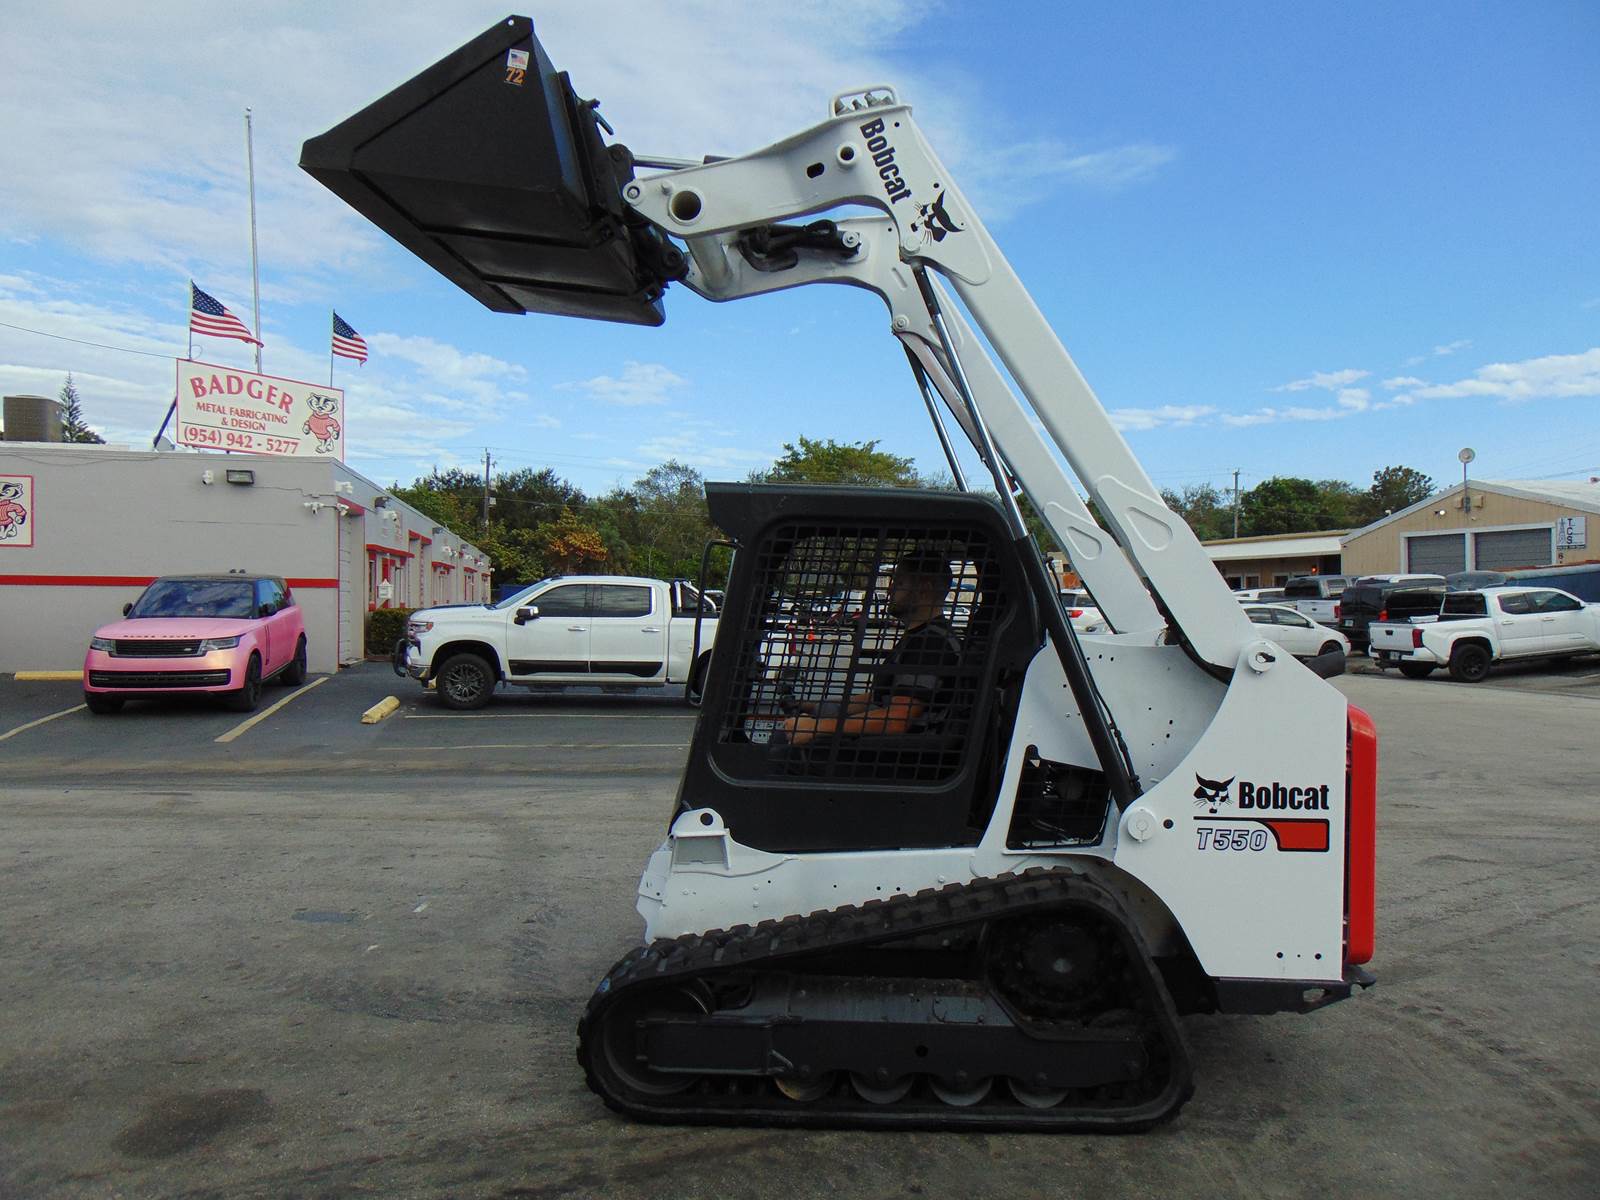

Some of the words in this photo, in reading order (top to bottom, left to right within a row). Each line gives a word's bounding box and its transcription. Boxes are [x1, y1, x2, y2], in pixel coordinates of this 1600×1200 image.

[860, 117, 912, 205] Bobcat
[190, 375, 293, 414] BADGER
[196, 402, 227, 416] METAL
[229, 407, 288, 425] FABRICATING
[221, 417, 228, 426] &
[231, 418, 266, 432] DESIGN
[184, 425, 222, 446] (954)
[226, 432, 253, 449] 942
[266, 438, 299, 455] 5277
[1239, 782, 1329, 809] Bobcat
[1197, 828, 1267, 851] T550
